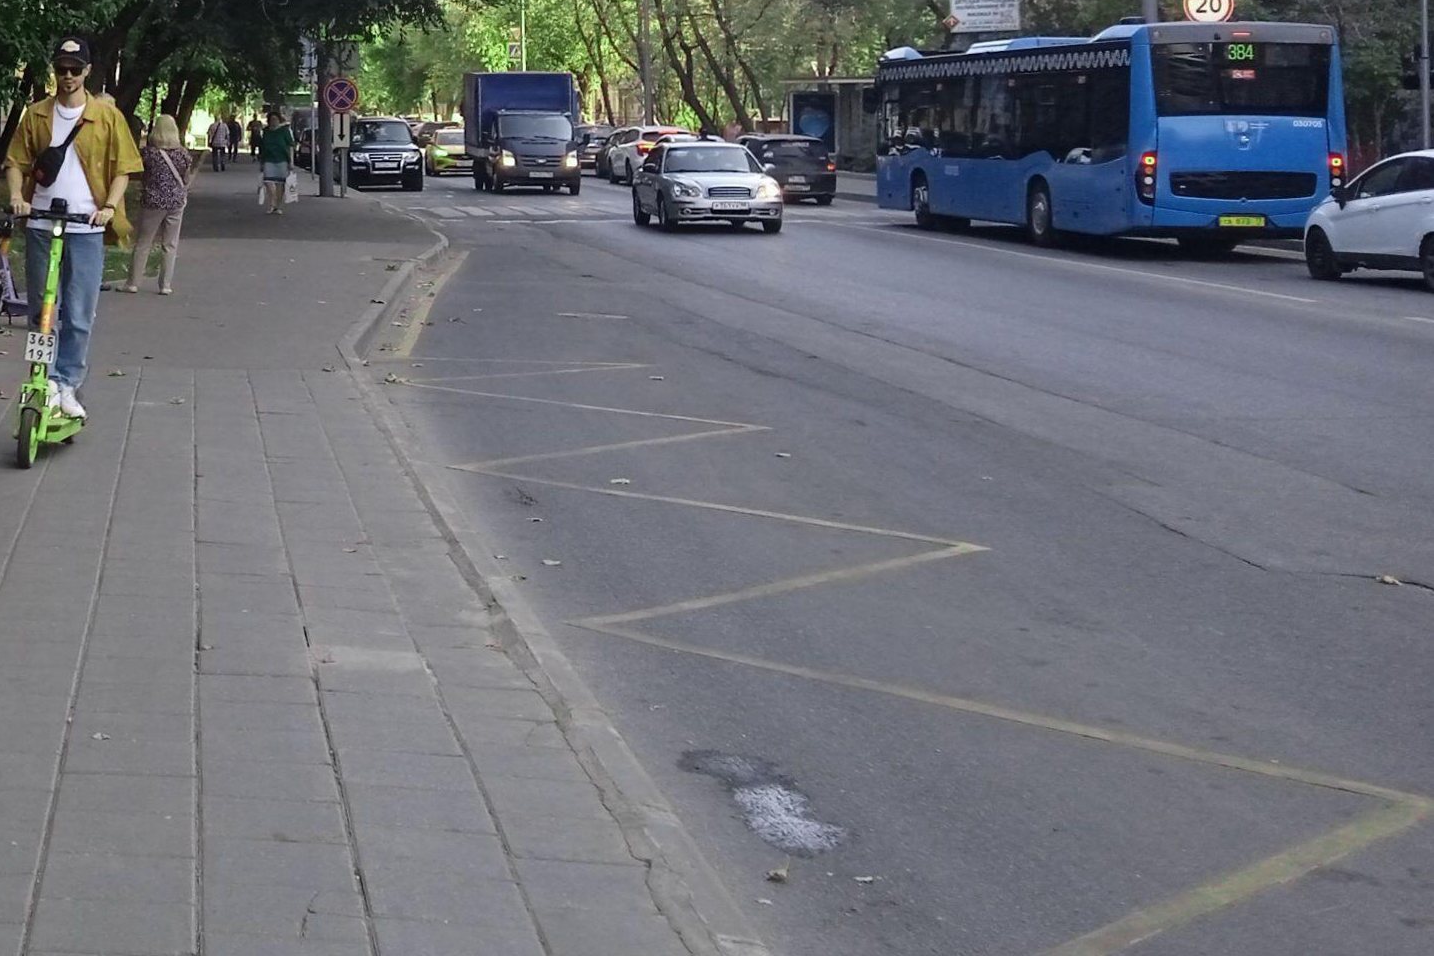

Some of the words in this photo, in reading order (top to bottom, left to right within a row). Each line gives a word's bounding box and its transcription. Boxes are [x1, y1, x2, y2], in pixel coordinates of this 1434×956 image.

[1228, 44, 1254, 60] 384
[29, 333, 54, 347] 365
[28, 348, 52, 362] 191
